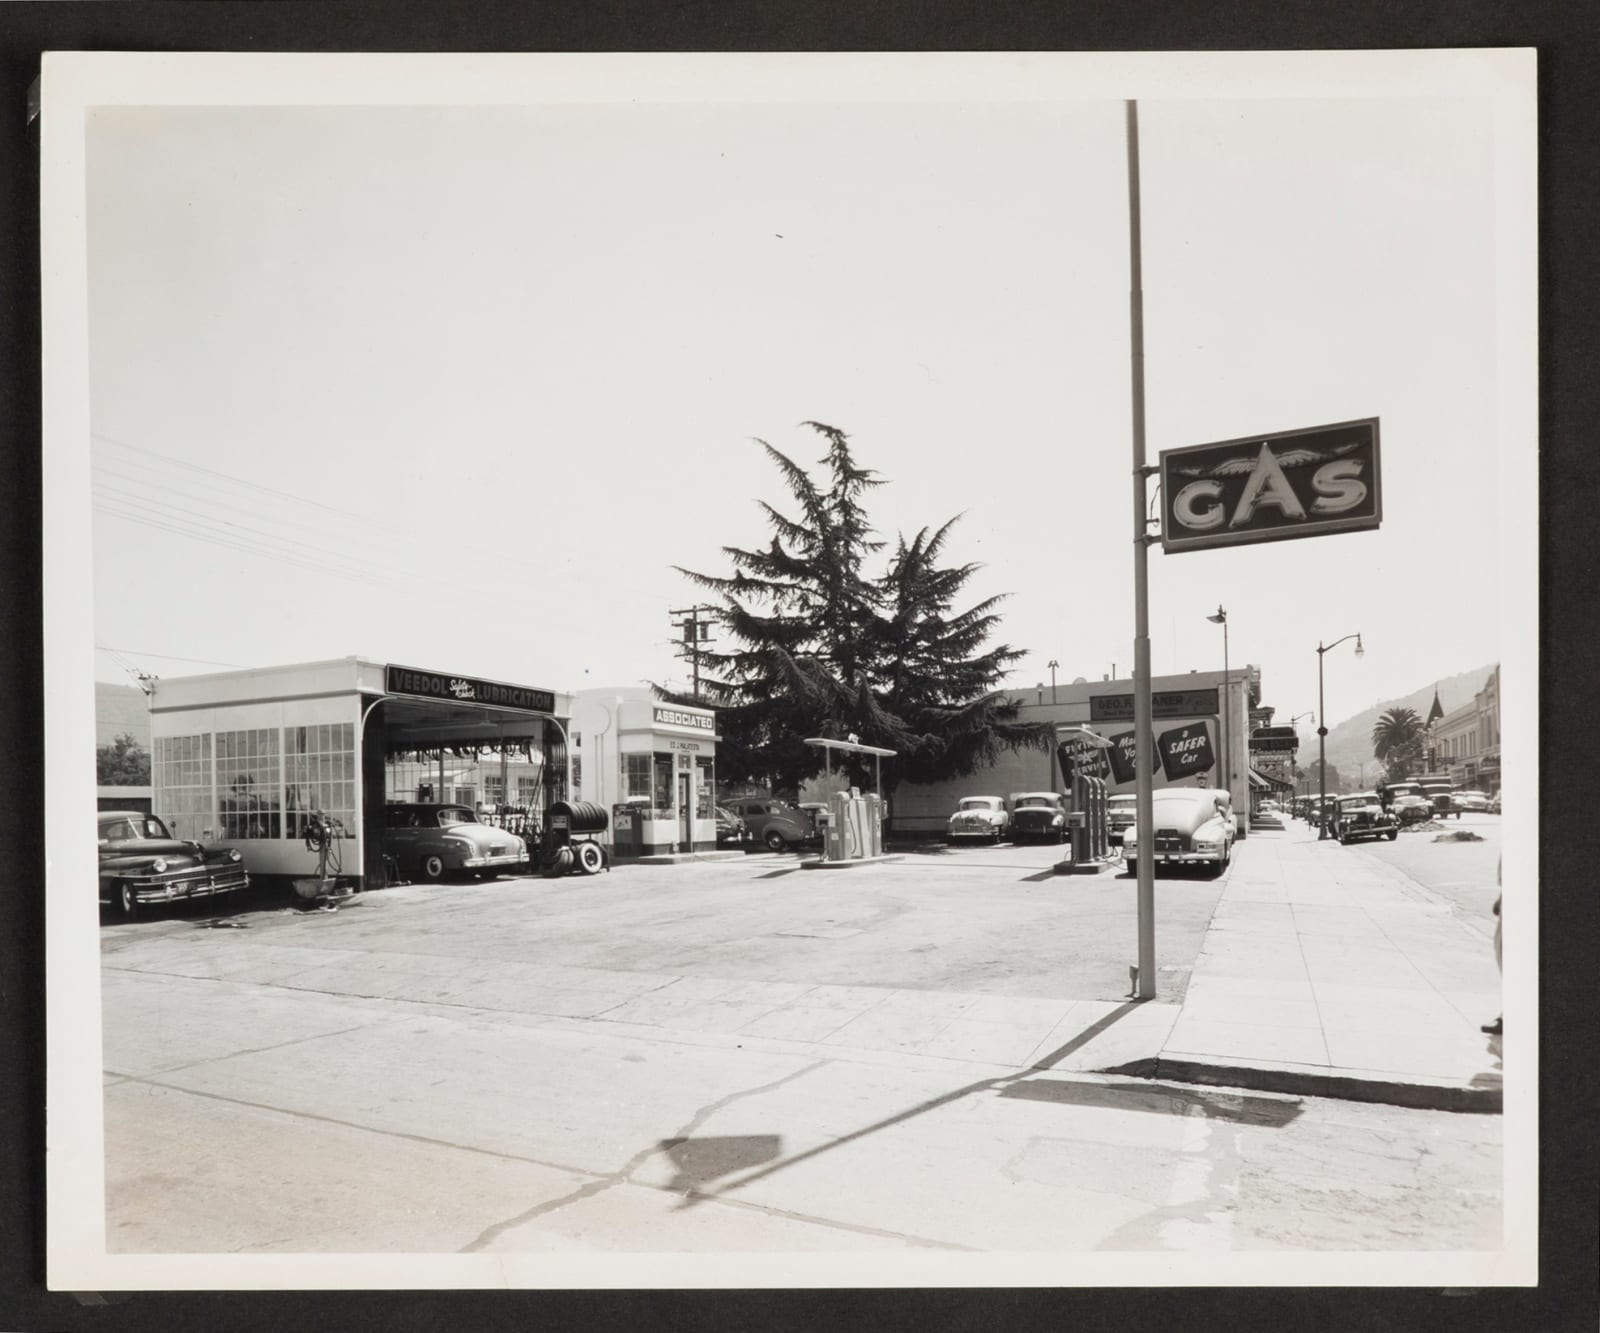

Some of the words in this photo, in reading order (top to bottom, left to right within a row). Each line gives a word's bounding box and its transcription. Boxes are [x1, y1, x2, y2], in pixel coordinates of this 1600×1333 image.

[1173, 441, 1369, 530] GAS
[393, 669, 448, 695] VEEDOL
[476, 684, 552, 710] LUBRICATION
[656, 709, 713, 729] ASSOCIATED
[1168, 735, 1207, 754] SAFER
[1180, 753, 1198, 764] Car
